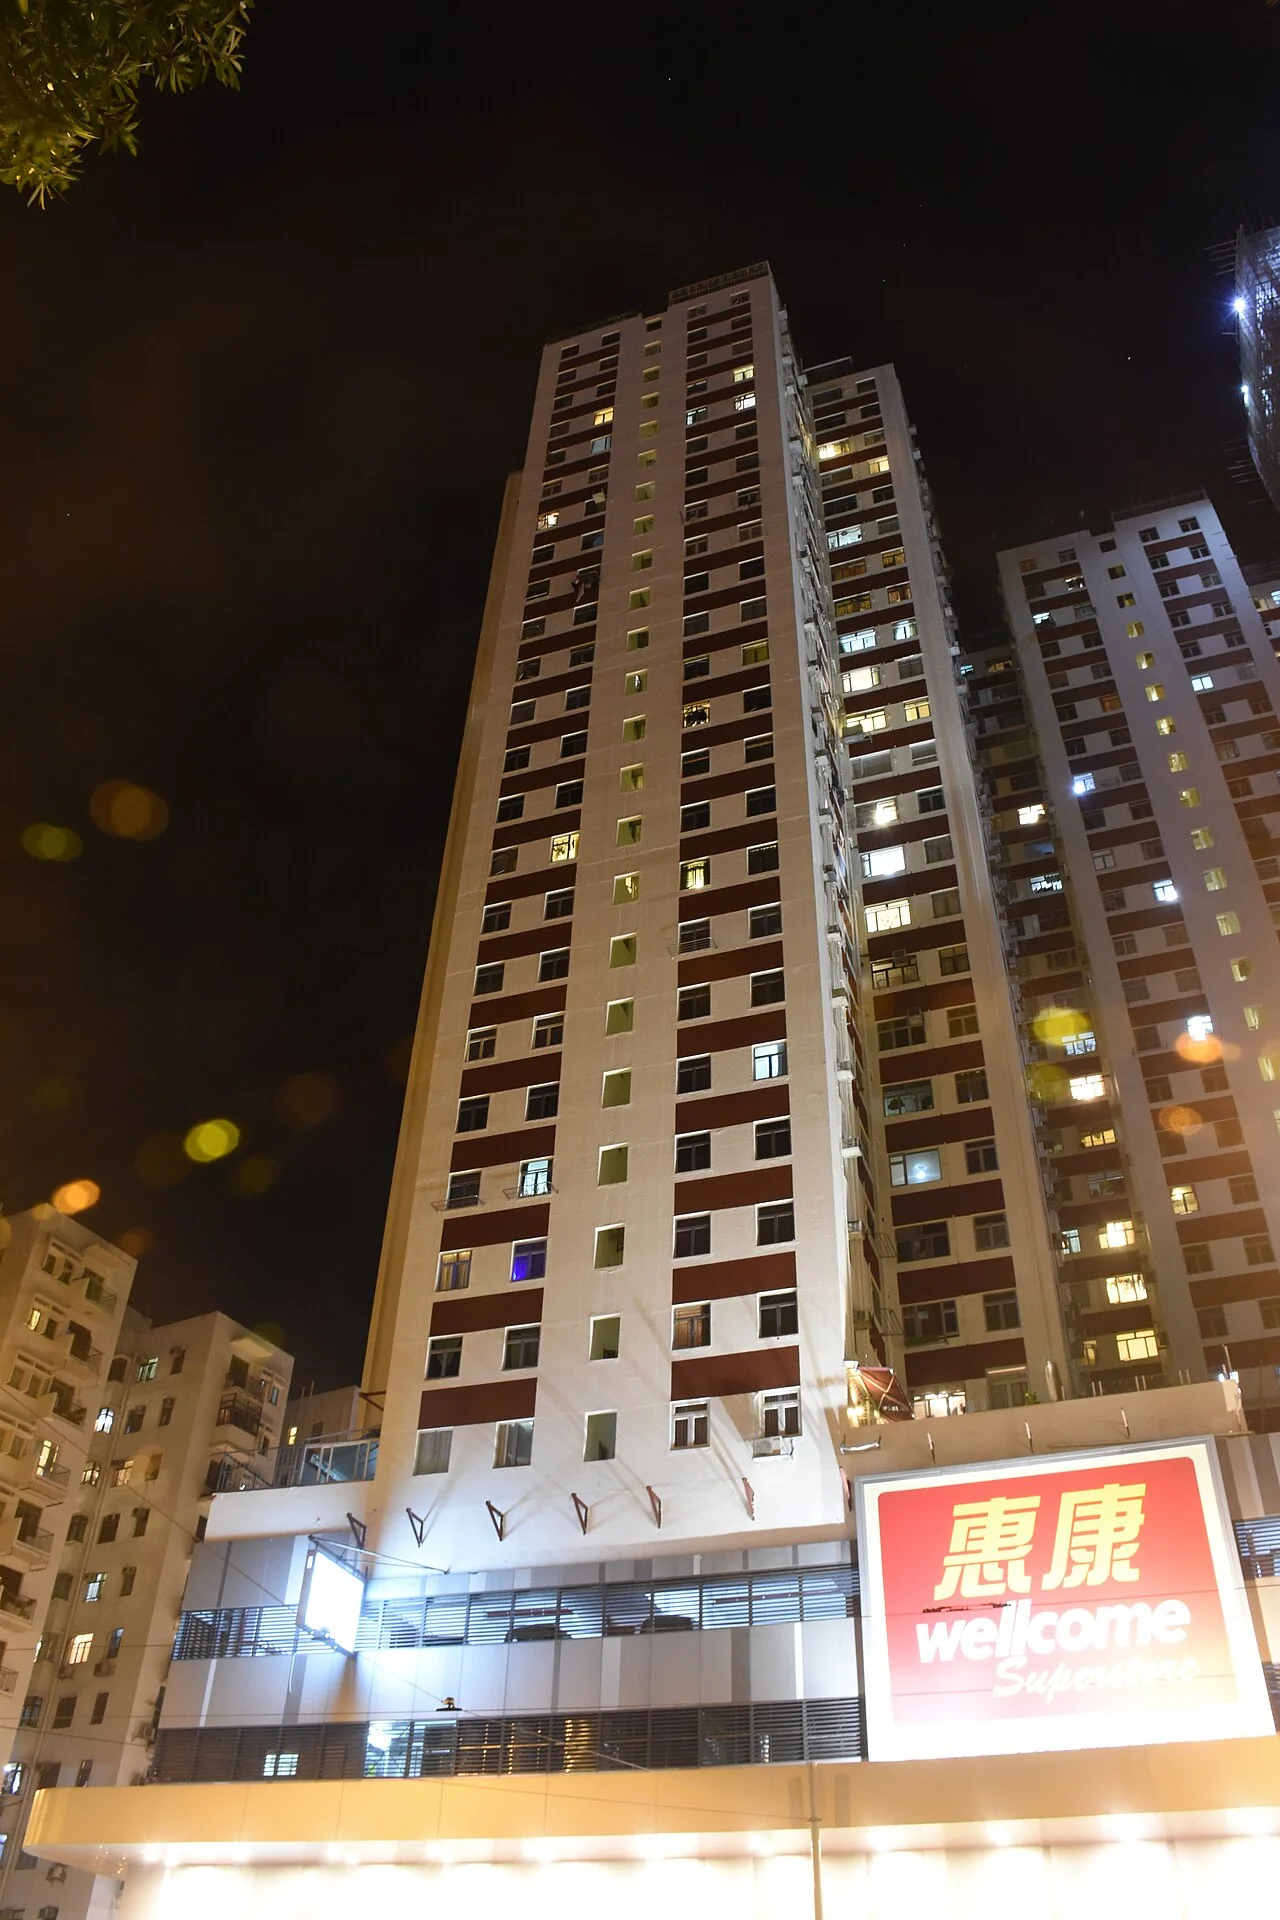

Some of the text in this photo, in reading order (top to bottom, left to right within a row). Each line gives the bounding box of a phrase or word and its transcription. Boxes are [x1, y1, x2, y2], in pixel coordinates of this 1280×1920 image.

[934, 1484, 1147, 1600] 惠康
[916, 1599, 1191, 1663] wellcome
[993, 1655, 1198, 1703] Superstore
